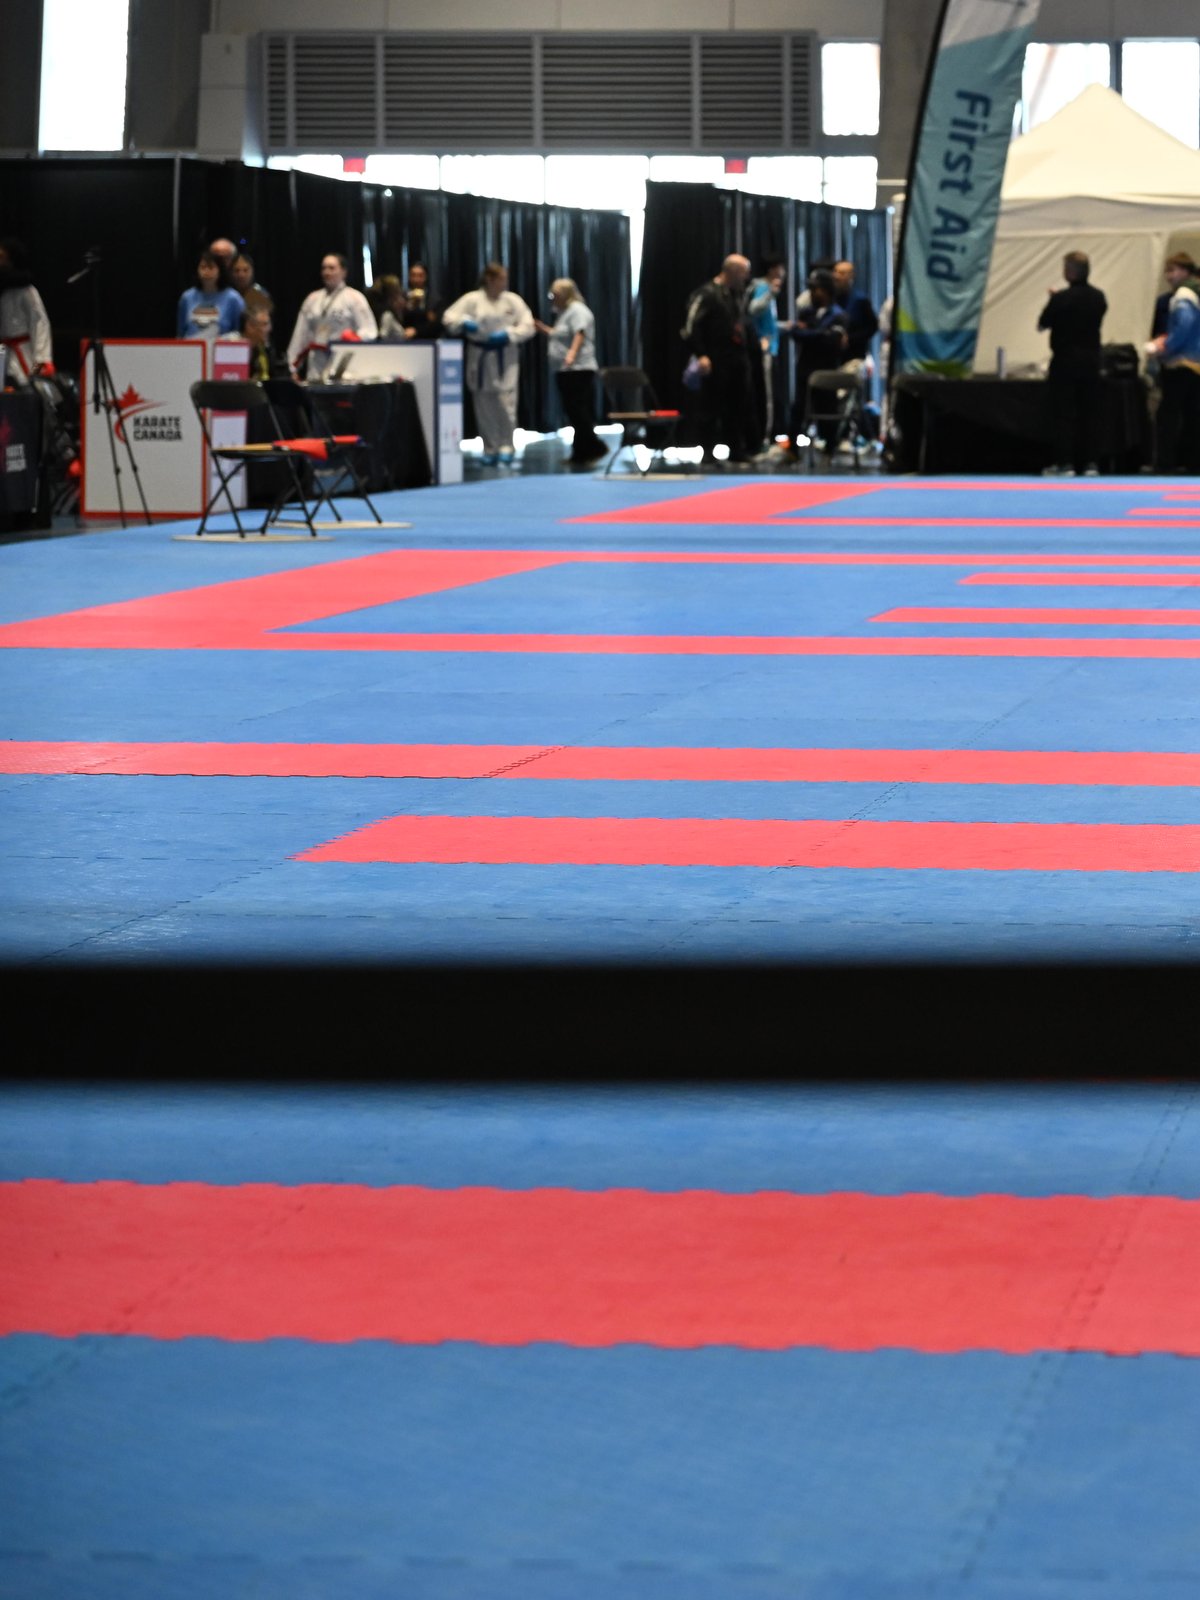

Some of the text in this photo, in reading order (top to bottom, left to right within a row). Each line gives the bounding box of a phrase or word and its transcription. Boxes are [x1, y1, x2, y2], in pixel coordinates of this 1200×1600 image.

[926, 89, 992, 283] First Aid
[133, 429, 182, 441] CANADA
